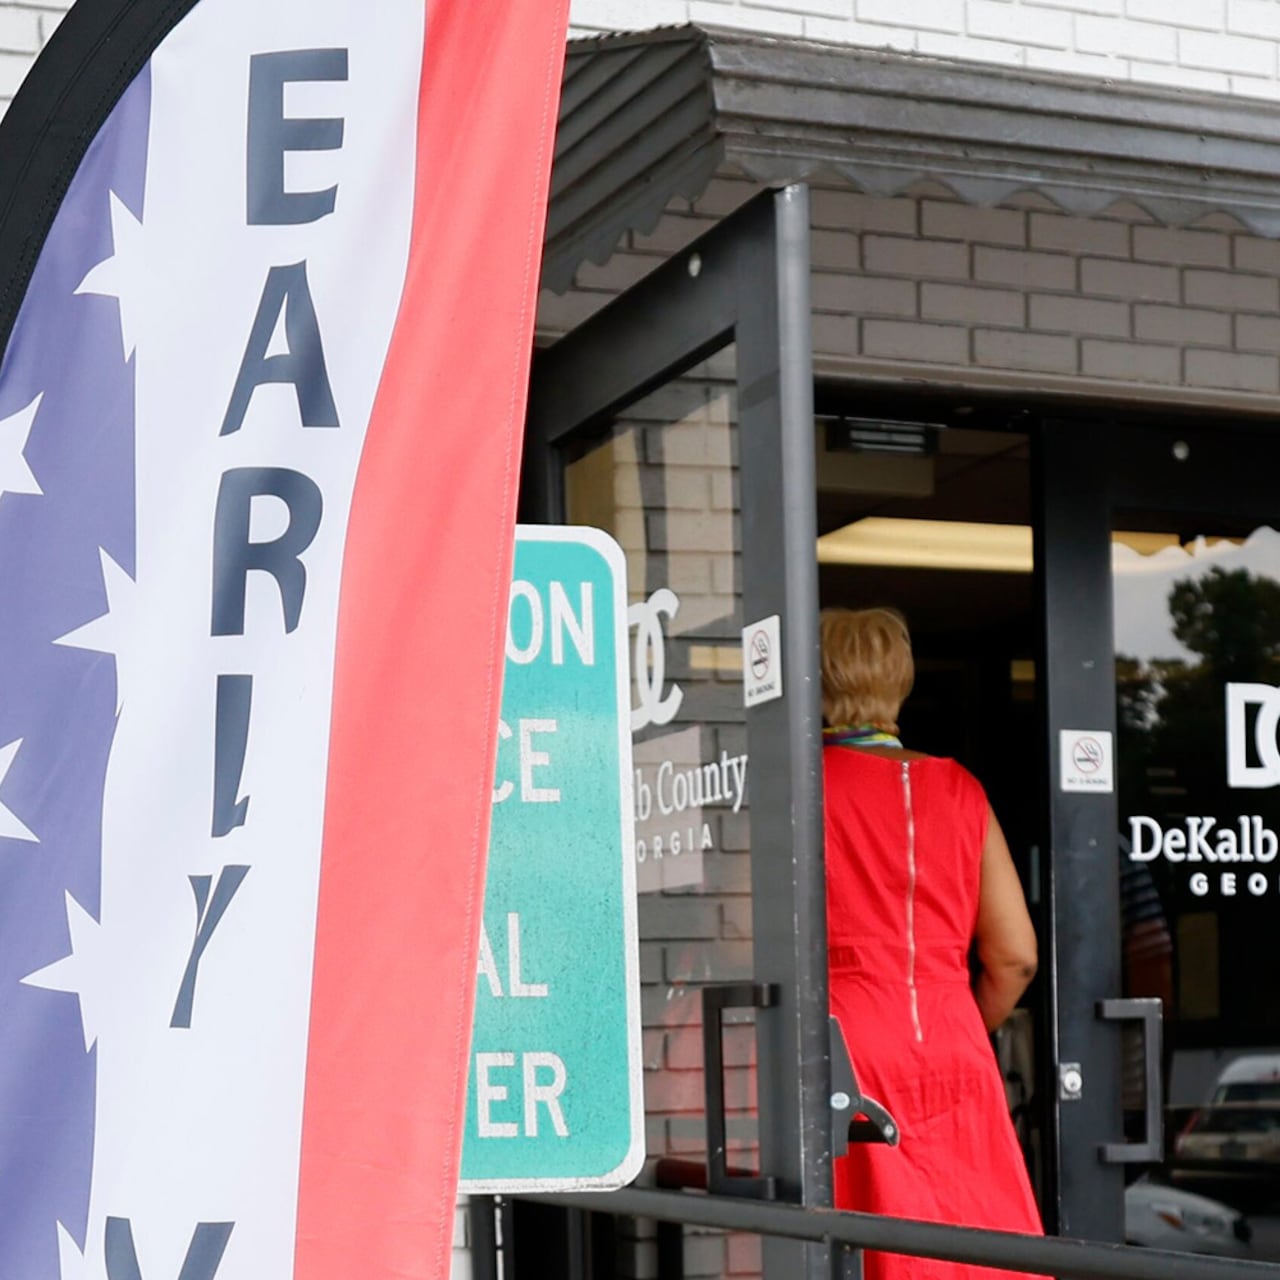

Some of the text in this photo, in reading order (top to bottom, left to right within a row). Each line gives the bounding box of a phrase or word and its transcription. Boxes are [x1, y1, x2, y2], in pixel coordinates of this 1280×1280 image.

[506, 579, 595, 666] ON
[657, 750, 749, 815] County
[637, 822, 714, 863] ORGIA
[1128, 814, 1279, 864] DeKalb
[476, 1051, 570, 1139] ER
